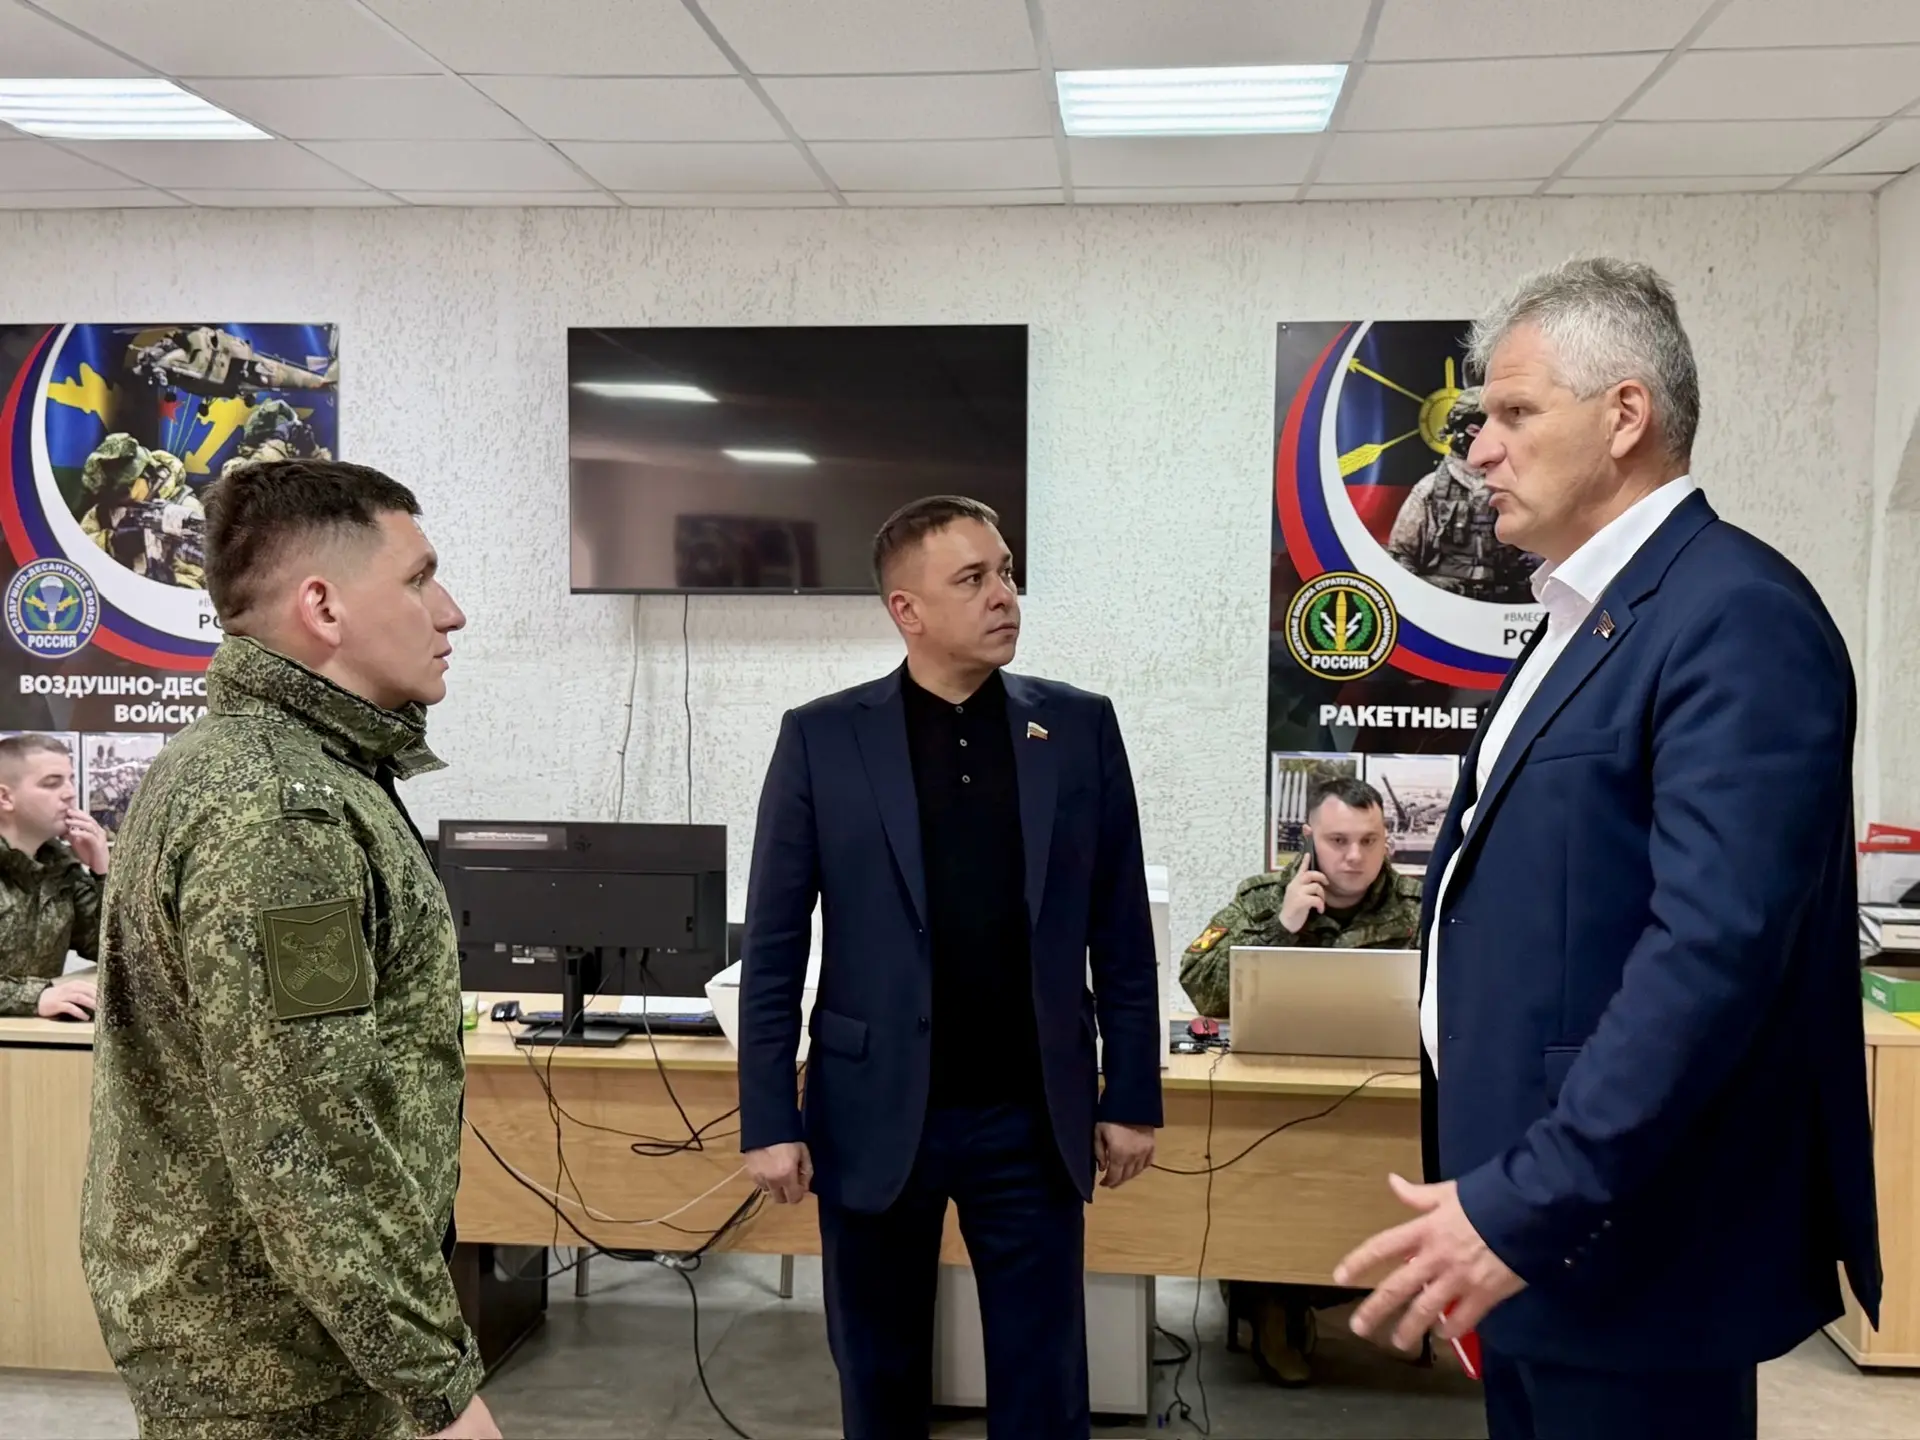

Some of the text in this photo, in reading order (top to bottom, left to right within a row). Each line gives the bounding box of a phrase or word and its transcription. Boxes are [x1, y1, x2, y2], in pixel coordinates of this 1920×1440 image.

[9, 563, 96, 635] ВОЗДУШНО-ДЕСАНТНЫЕ ВОЙСКА
[28, 635, 77, 648] РОССИЯ
[1311, 655, 1369, 670] РОССИЯ
[1319, 705, 1477, 729] РАКЕТНЫЕ
